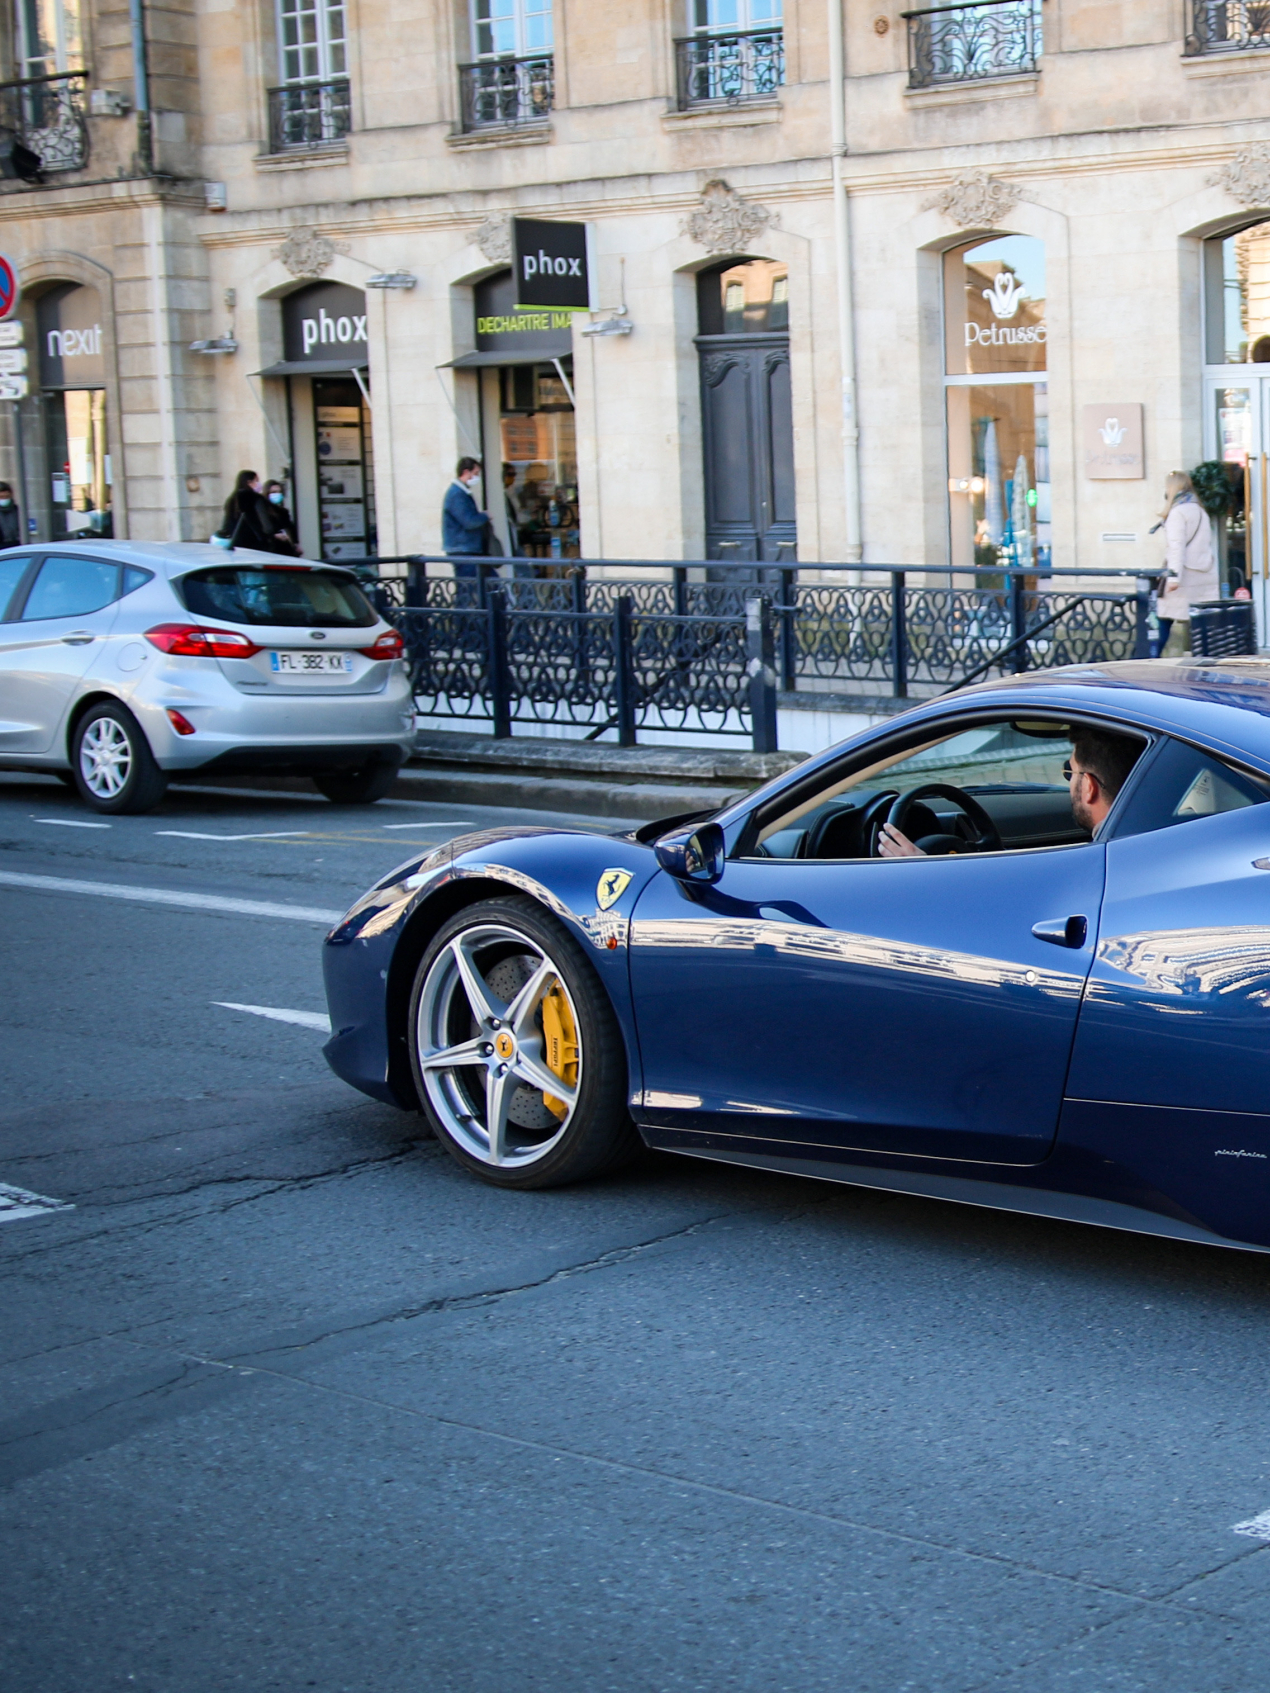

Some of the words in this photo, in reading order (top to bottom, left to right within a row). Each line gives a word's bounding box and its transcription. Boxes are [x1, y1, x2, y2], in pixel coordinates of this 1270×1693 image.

[523, 249, 582, 281] phox
[302, 308, 368, 355] phox
[477, 313, 549, 334] DECHARTRE
